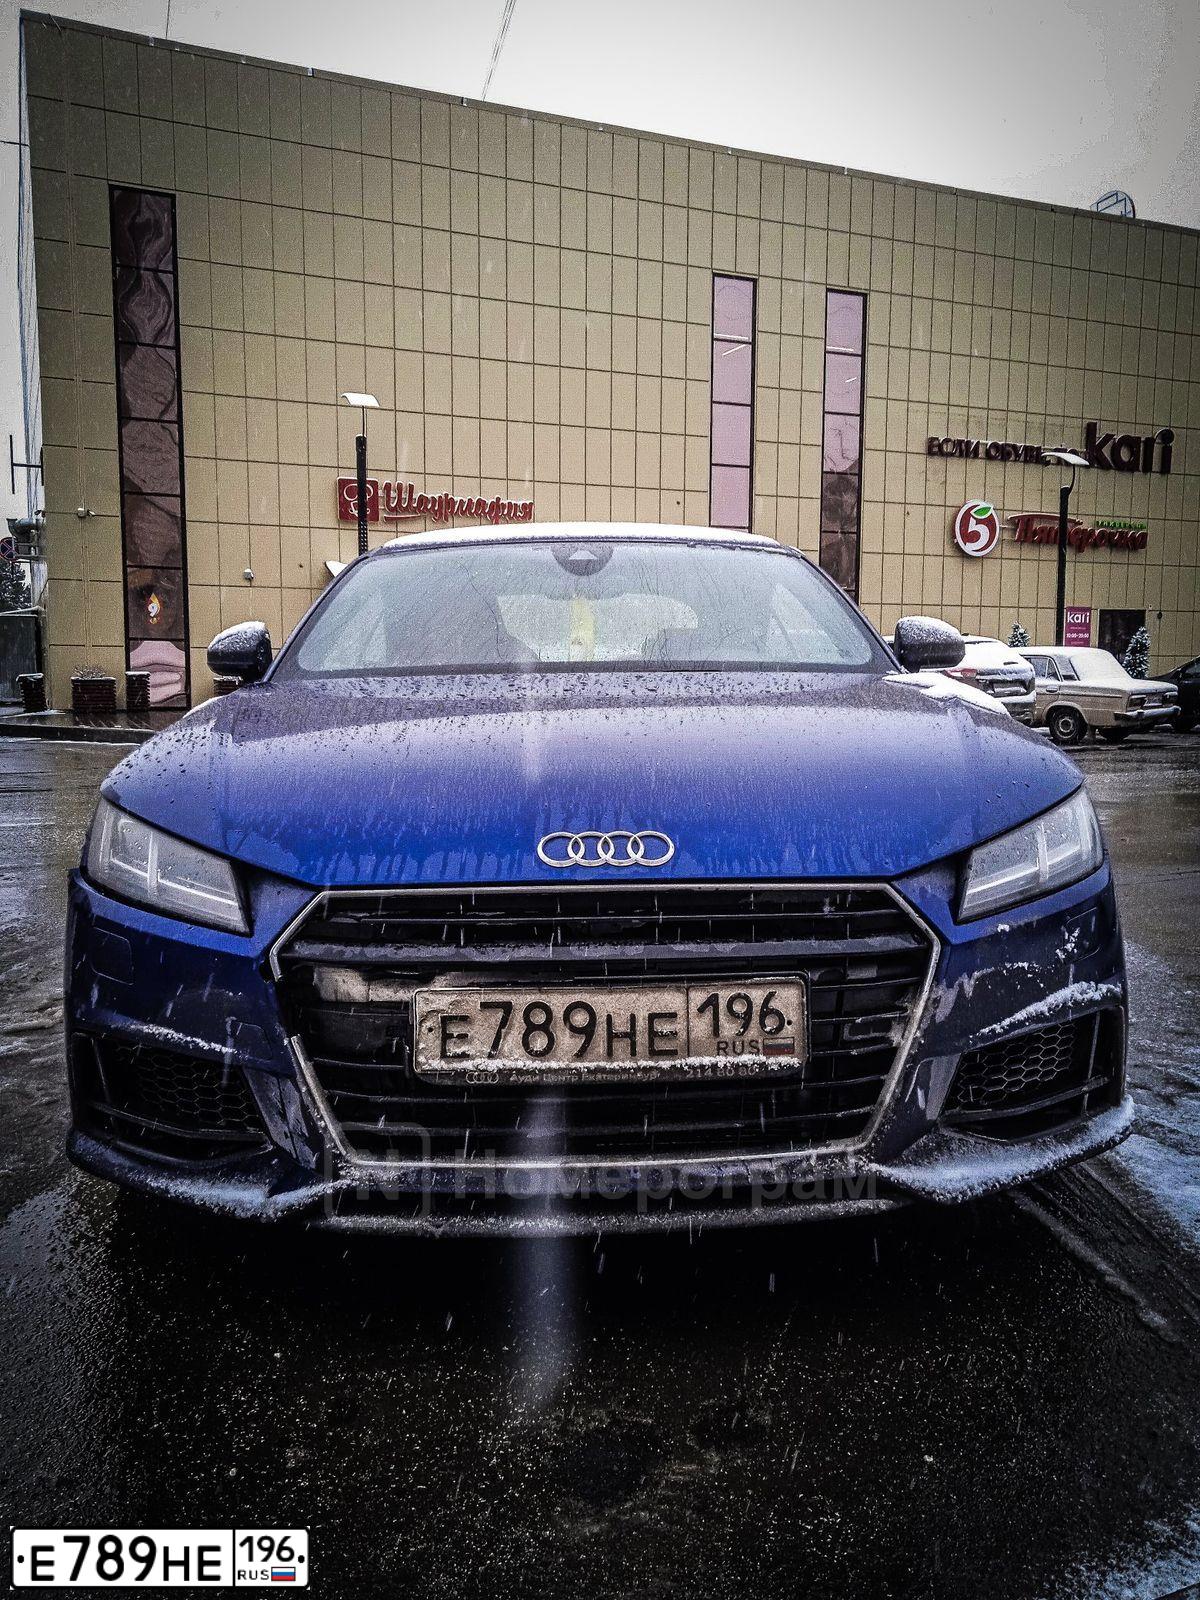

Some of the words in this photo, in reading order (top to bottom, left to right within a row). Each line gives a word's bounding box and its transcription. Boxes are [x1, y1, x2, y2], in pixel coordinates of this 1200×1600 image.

[1085, 421, 1175, 474] kari
[383, 480, 535, 525] Шаурмафия
[1067, 611, 1090, 624] kari
[439, 1000, 679, 1059] Е789НЕ
[696, 990, 785, 1037] 196
[716, 1039, 761, 1056] RUS
